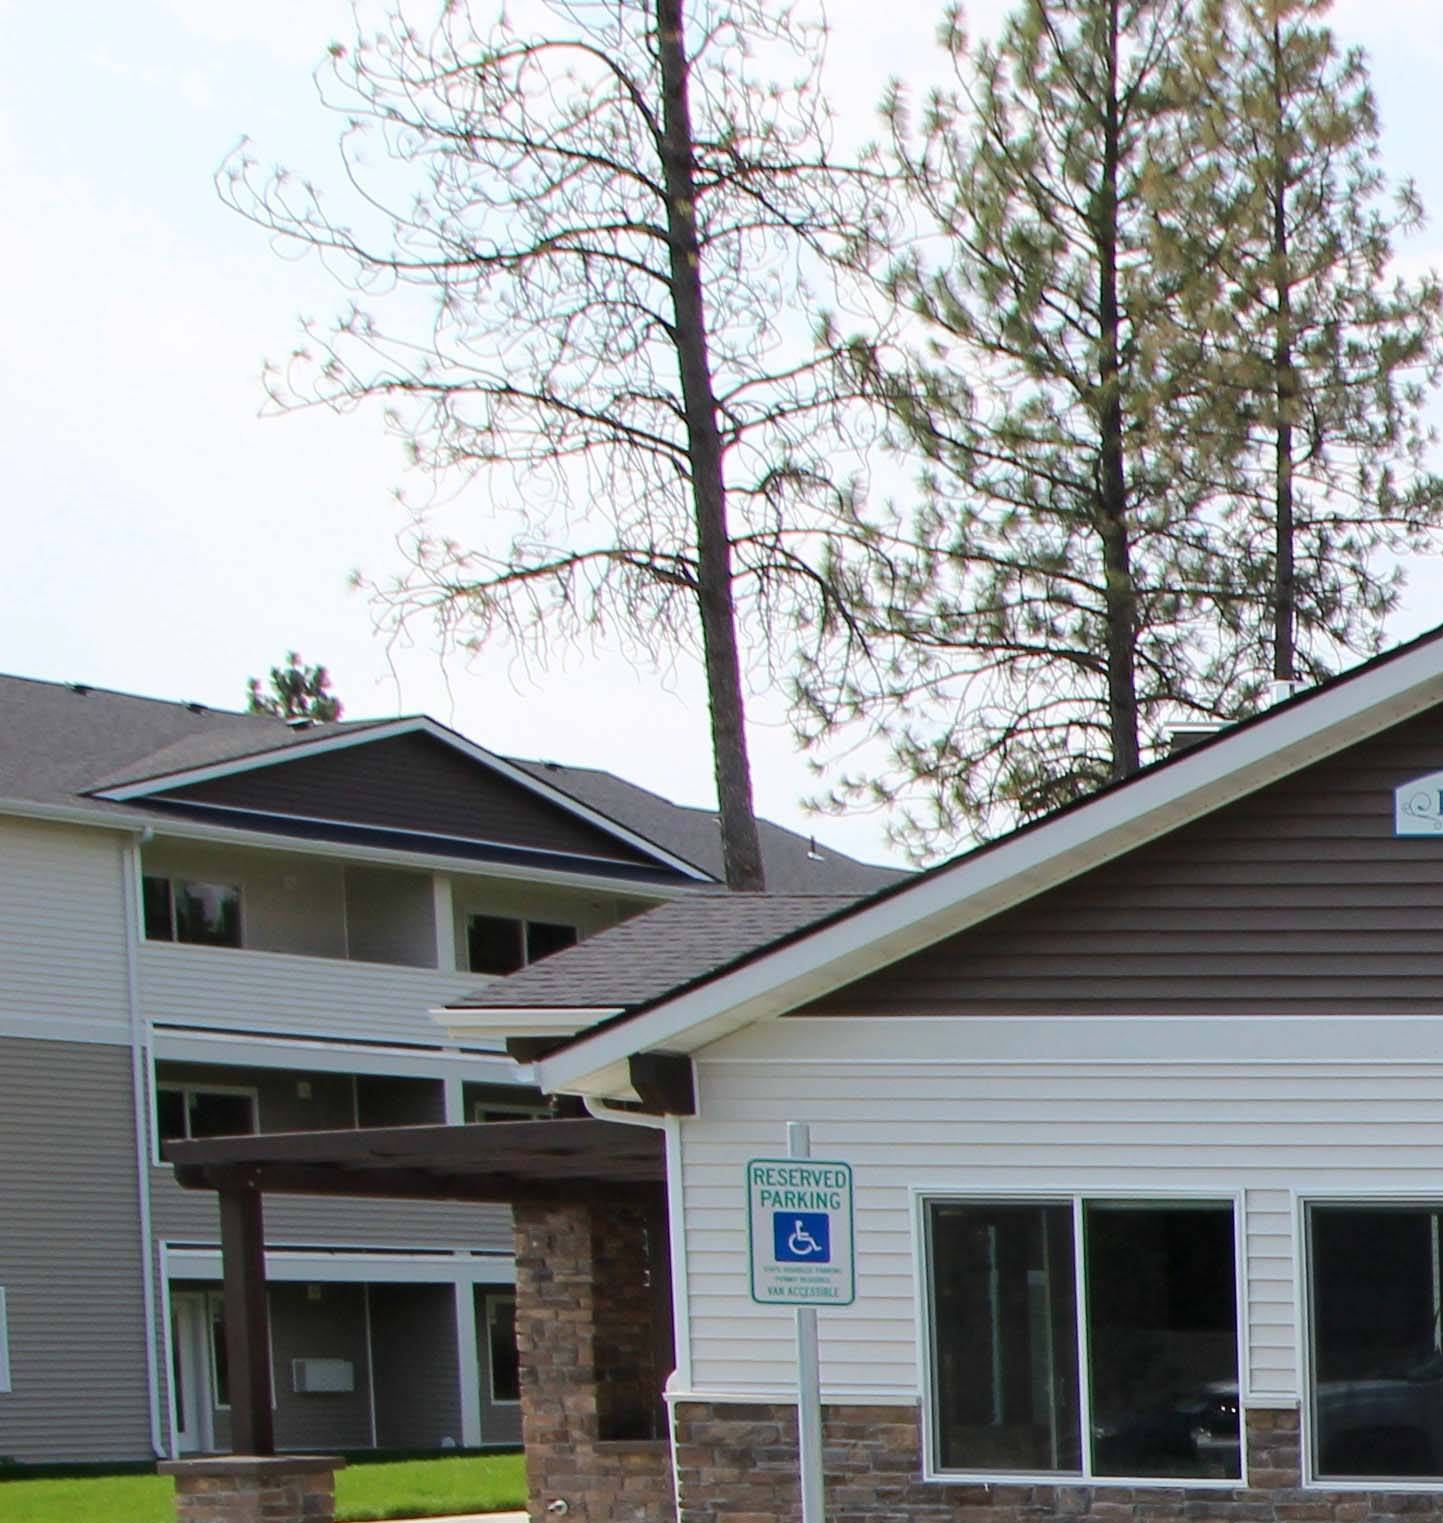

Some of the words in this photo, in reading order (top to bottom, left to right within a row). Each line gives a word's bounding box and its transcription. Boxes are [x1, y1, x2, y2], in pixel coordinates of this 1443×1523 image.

[753, 1167, 846, 1188] RESERVED
[760, 1190, 841, 1210] PARKING
[767, 1286, 784, 1297] VAN
[788, 1286, 839, 1298] ACCESSIBLE
